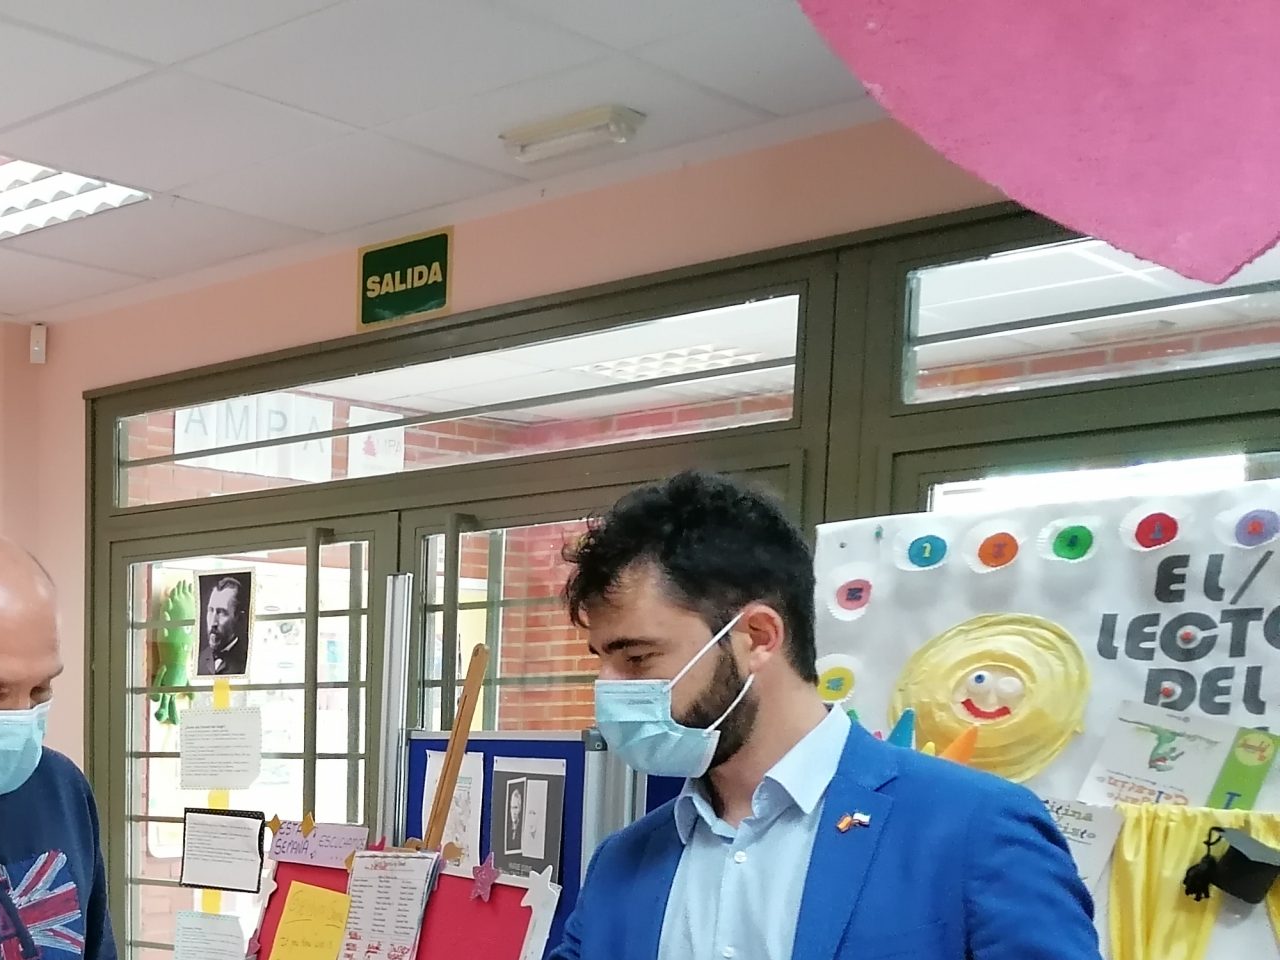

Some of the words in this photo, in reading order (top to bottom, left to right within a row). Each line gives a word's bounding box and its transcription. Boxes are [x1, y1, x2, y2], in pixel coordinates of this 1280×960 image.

[366, 261, 443, 298] SALIDA
[1096, 605, 1280, 663] LECT
[1143, 666, 1267, 716] DEL
